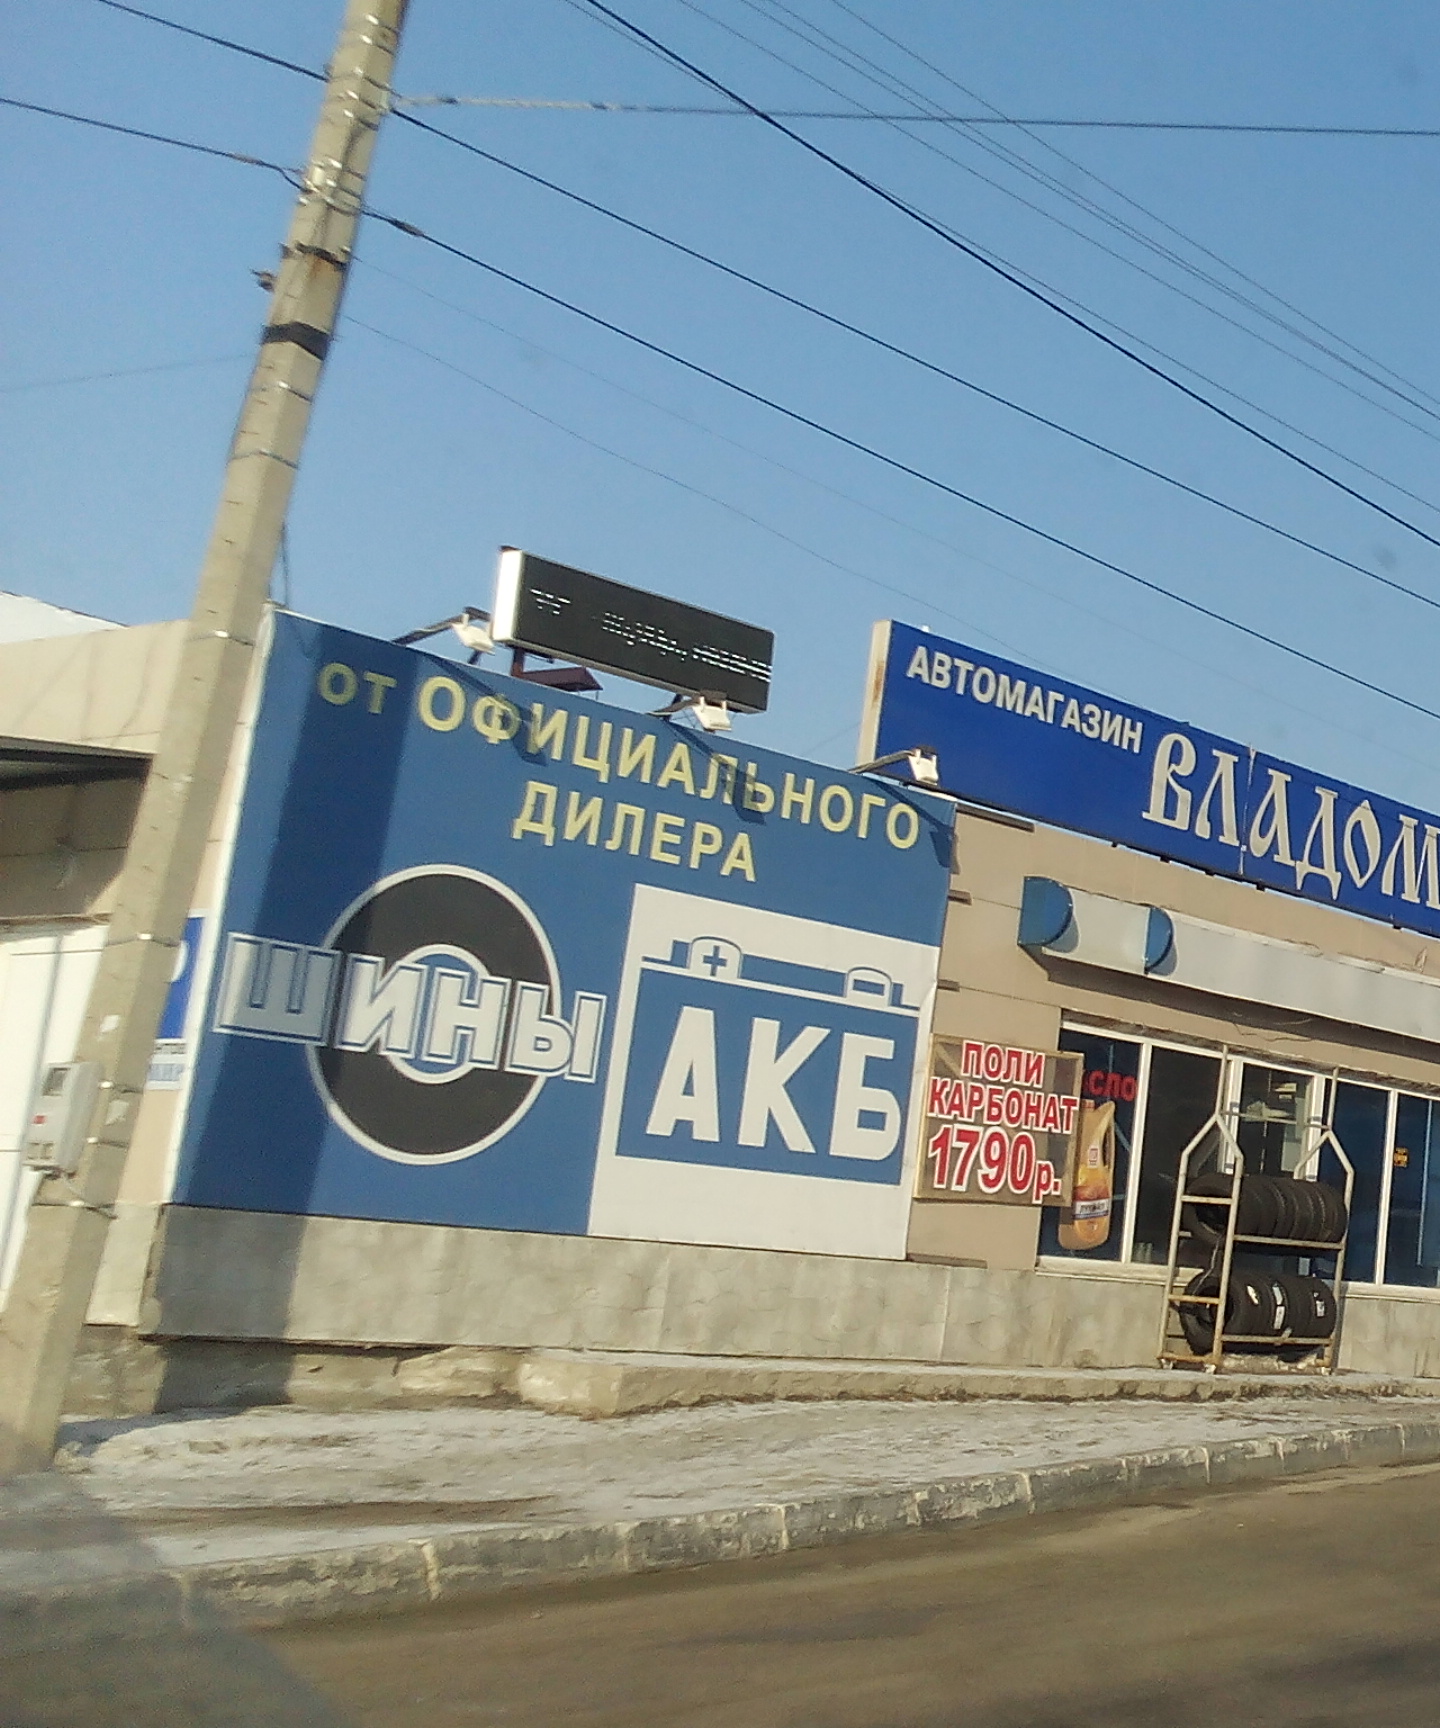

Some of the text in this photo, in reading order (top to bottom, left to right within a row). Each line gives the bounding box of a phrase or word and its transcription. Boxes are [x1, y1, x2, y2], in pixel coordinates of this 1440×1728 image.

[906, 645, 1143, 754] АВТОМАГАЗИН
[416, 675, 920, 849] ОФИЦИАЛЬНОГО
[511, 780, 756, 882] ДИЛЕРА
[645, 1004, 902, 1162] АКБ
[927, 1077, 1080, 1135] КАРБОНАТ
[961, 1040, 1046, 1088] ПОЛИ
